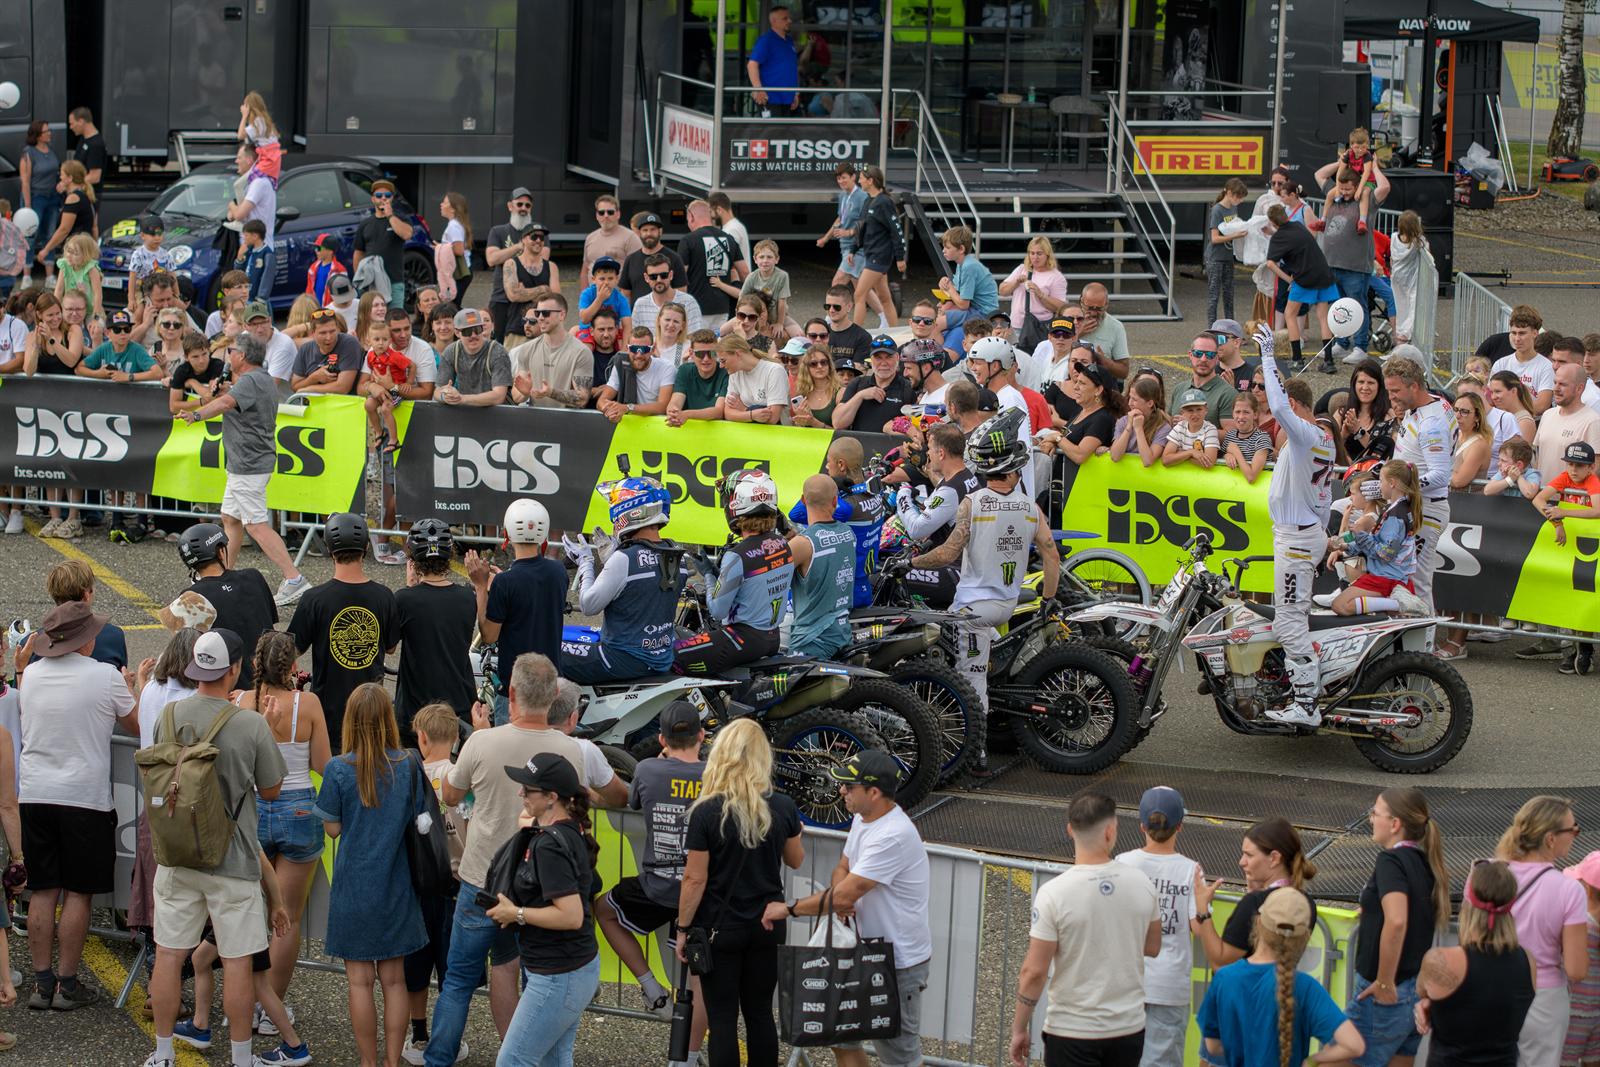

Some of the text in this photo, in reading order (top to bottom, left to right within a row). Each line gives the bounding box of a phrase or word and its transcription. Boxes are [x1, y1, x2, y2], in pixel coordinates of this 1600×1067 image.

[677, 121, 711, 157] YAMAHA
[769, 140, 870, 159] TISSOT
[1138, 141, 1258, 170] PIRELLI
[730, 161, 763, 172] SWISS
[766, 161, 811, 172] WATCHES
[14, 466, 66, 480] ixs.com
[435, 500, 471, 511] ixs.com
[613, 495, 649, 514] SCOTT
[998, 537, 1022, 546] CIRCUS
[1160, 880, 1189, 896] Have
[1173, 910, 1179, 923] A
